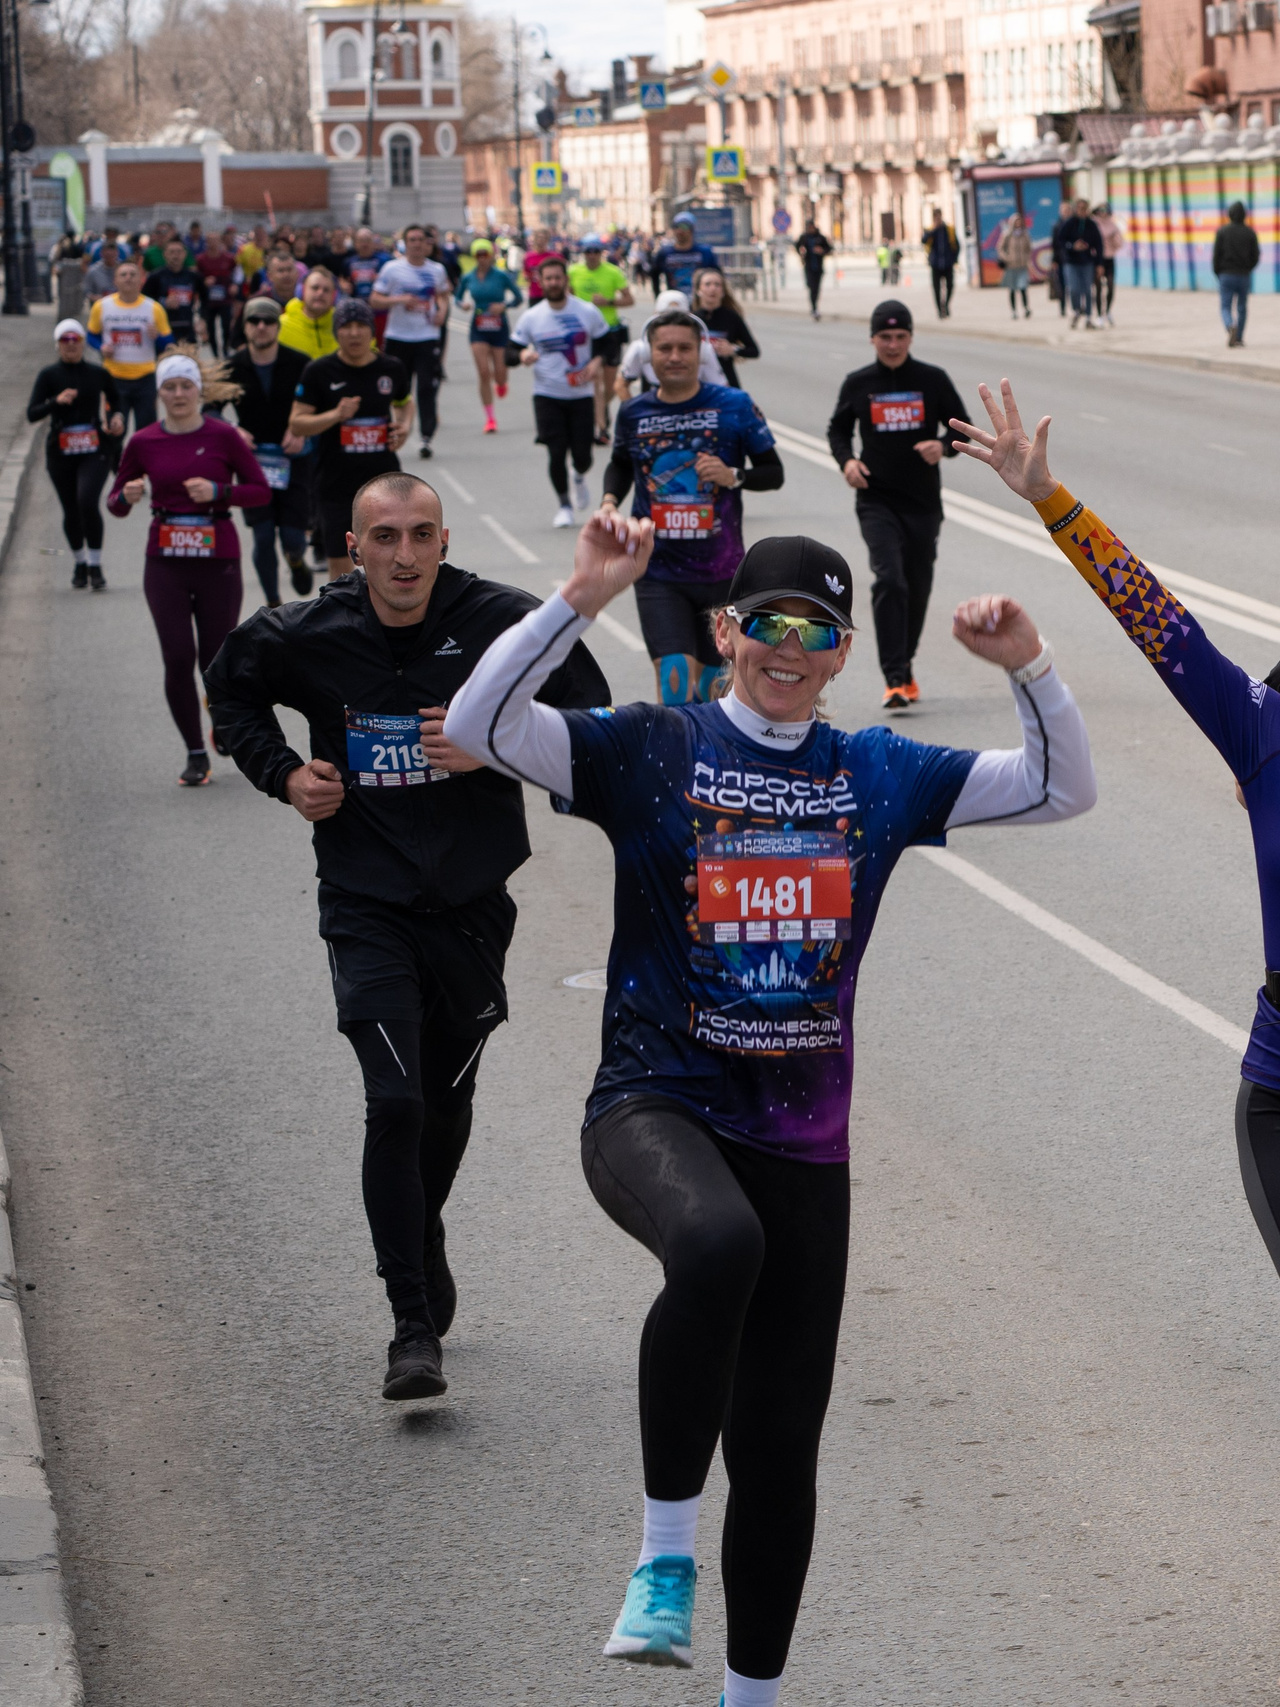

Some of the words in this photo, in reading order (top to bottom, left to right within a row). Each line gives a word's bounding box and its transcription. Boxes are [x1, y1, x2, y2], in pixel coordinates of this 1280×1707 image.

[637, 418, 719, 434] КОСМОС
[664, 511, 699, 528] 1016
[170, 531, 203, 548] 1042
[371, 743, 428, 771] 2119
[722, 770, 848, 797] ПРОСТО
[693, 780, 857, 817] КОСМОС
[744, 845, 802, 854] КОСМОС
[753, 837, 802, 845] ПРОСТО
[713, 880, 727, 894] E
[736, 876, 812, 917] 1481
[699, 1010, 841, 1034] КОСМИЧЕСКИЙ
[696, 1027, 842, 1050] ПОЛУМАРАФОН
